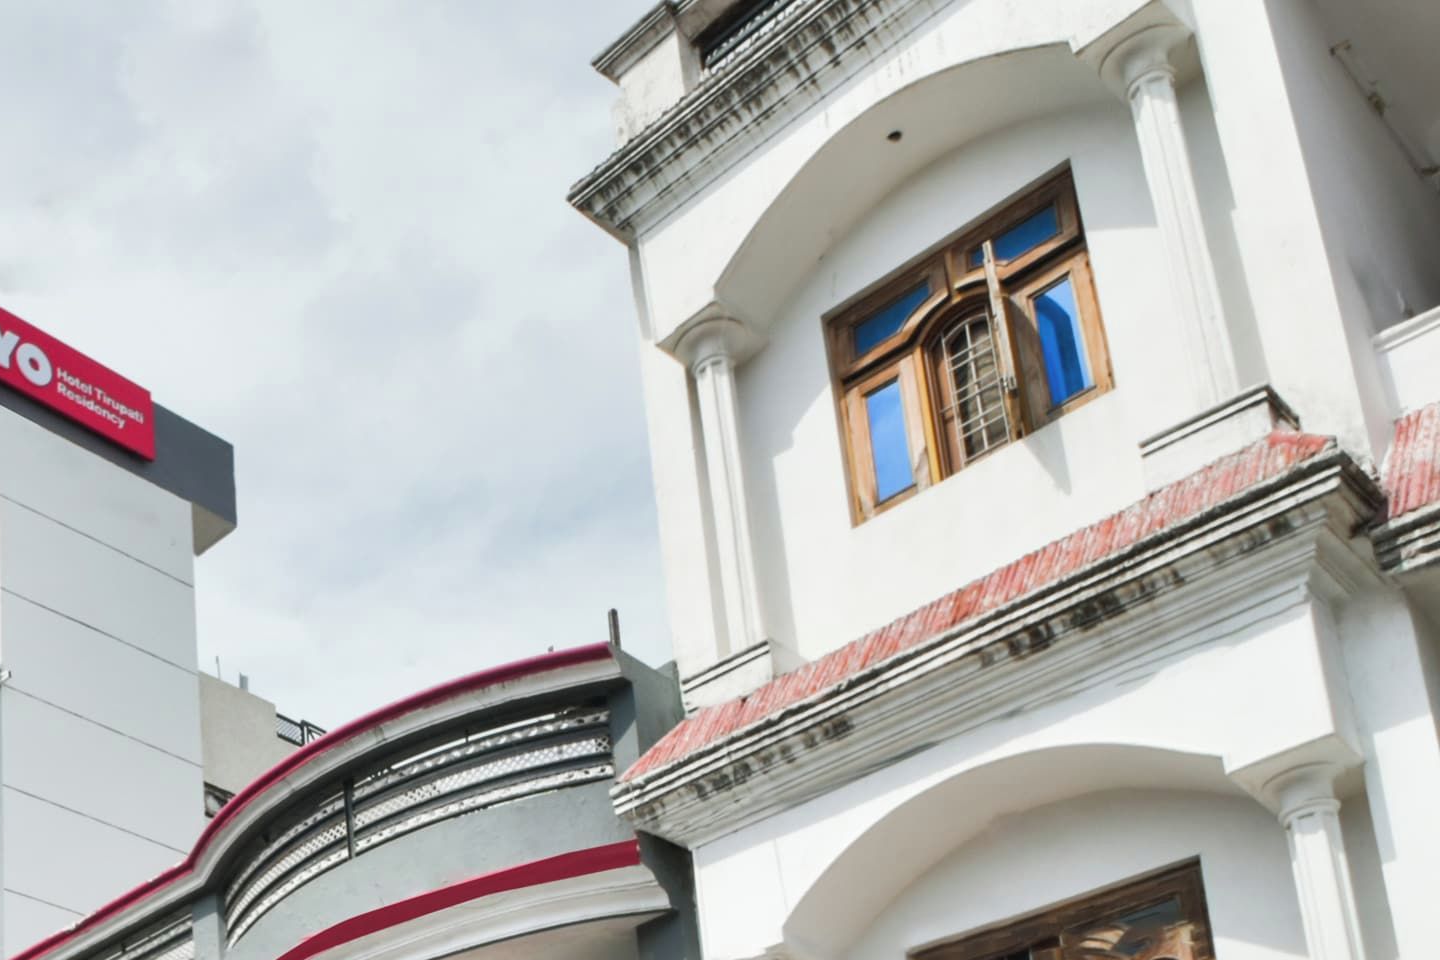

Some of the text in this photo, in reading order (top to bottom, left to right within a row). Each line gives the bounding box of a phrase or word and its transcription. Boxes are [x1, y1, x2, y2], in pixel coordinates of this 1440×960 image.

[57, 367, 145, 424] Hotel Tirupati
[57, 382, 125, 430] Residency
